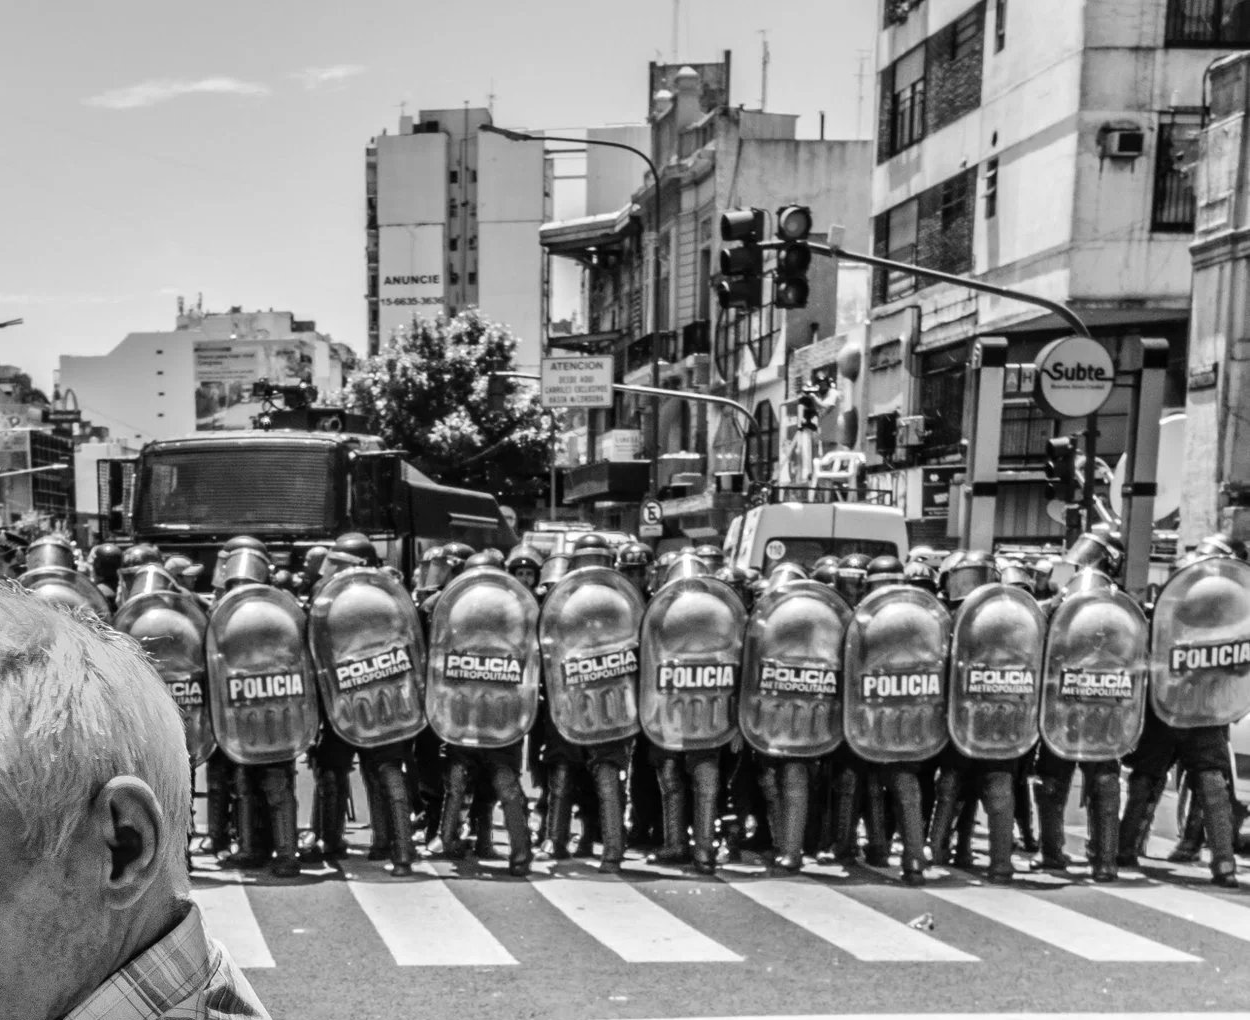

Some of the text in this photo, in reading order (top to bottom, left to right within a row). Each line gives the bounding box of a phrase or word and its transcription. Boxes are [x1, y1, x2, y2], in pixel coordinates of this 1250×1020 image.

[384, 274, 440, 285] ANUNCIE
[551, 361, 604, 371] ATENCION
[1052, 362, 1106, 381] Subte
[1023, 371, 1032, 383] H
[336, 649, 409, 681] POLICIA
[448, 655, 521, 673] POLICIA
[565, 651, 637, 676] POLICIA
[1173, 644, 1250, 669] POLICIA
[339, 662, 412, 690] METROPOLITANA
[446, 669, 521, 683] METROPOLITANA
[566, 663, 638, 685] METROPOLITANA
[660, 666, 734, 688] POLICIA
[762, 667, 837, 685] POLICIA
[970, 671, 1034, 685] POLICIA
[1063, 671, 1132, 689] POLICIA
[230, 674, 303, 700] POLICIA
[760, 681, 837, 694] METROPOLITANA
[864, 674, 940, 697] POLICIA
[969, 684, 1034, 695] METROPOLITANA
[1062, 686, 1132, 699] METROPOLITANA
